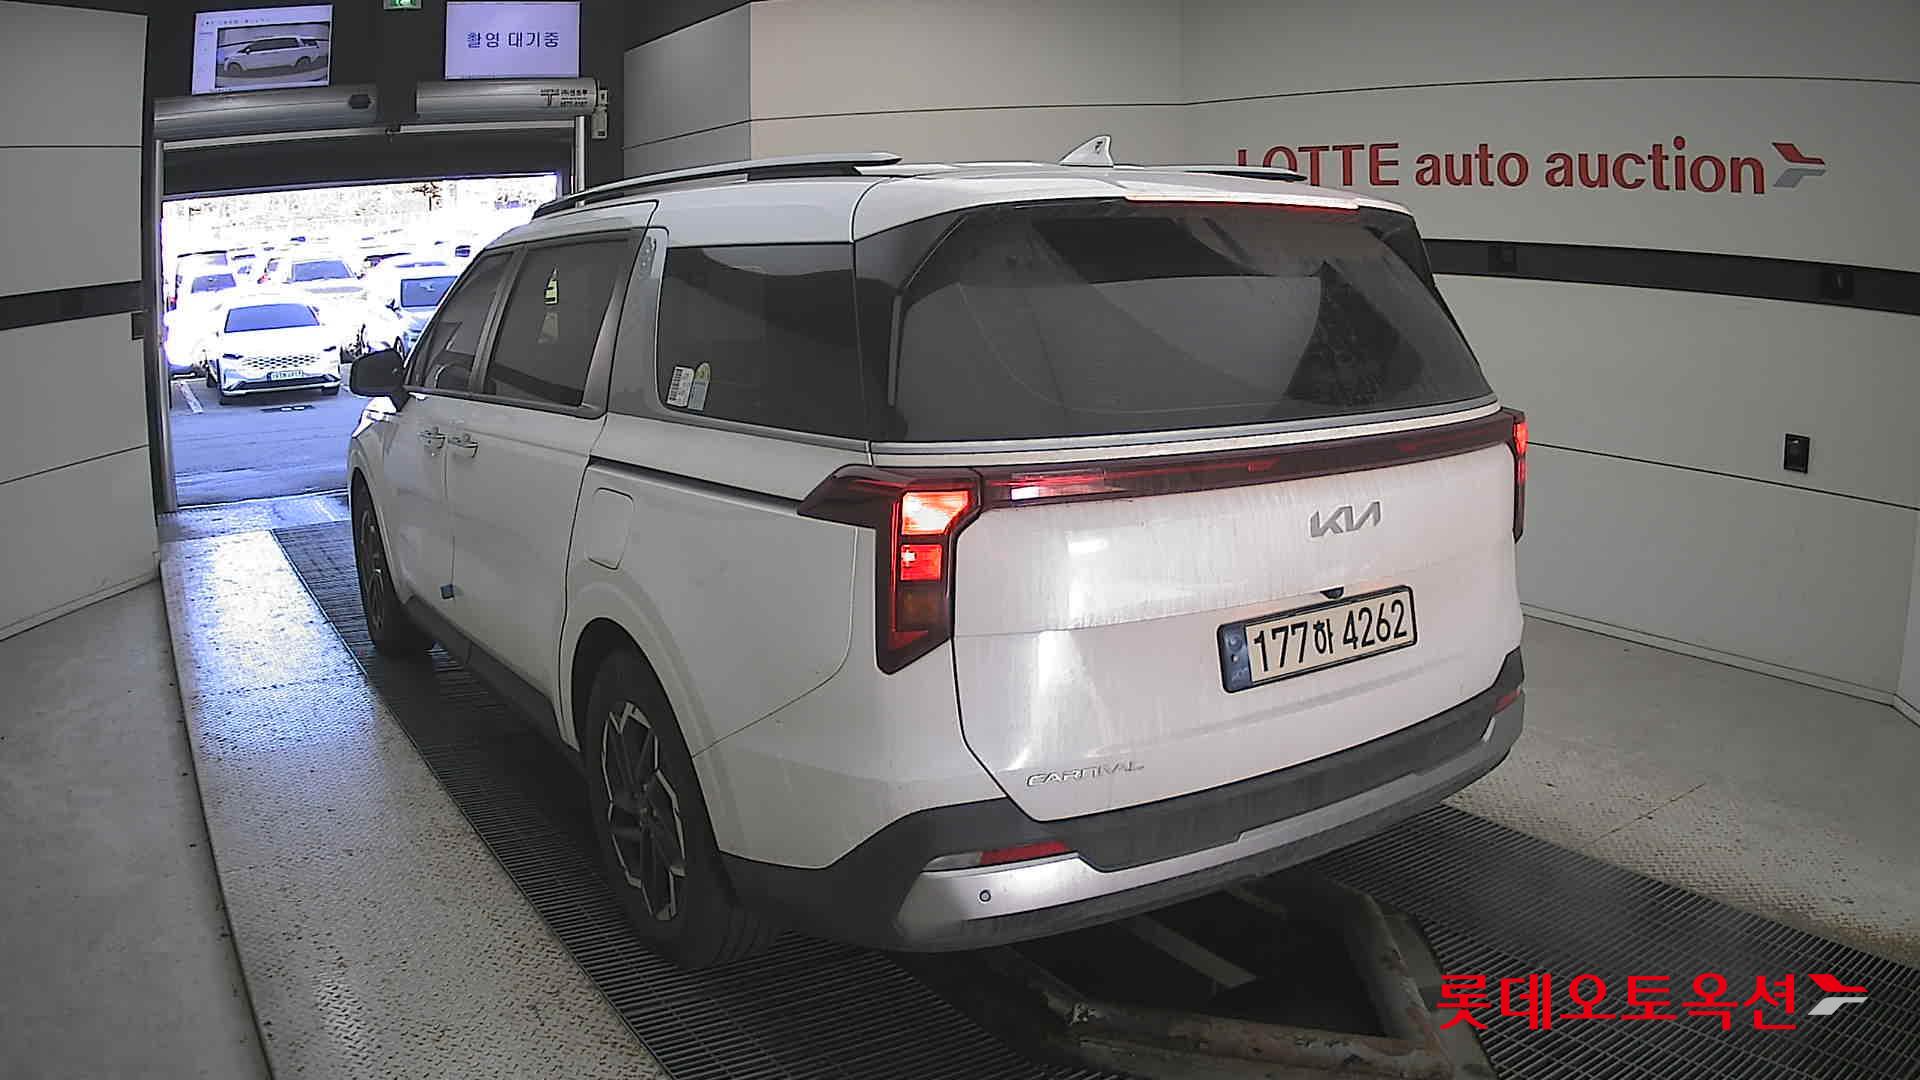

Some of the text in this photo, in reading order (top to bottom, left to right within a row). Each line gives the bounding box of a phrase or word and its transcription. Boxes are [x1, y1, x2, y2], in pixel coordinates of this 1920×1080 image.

[508, 32, 559, 48] 대기중
[1415, 143, 1529, 187] auto
[1545, 136, 1764, 194] auction
[1311, 501, 1380, 537] KIA
[1254, 600, 1408, 672] 177하 4262
[1026, 760, 1145, 787] CARNIVAL
